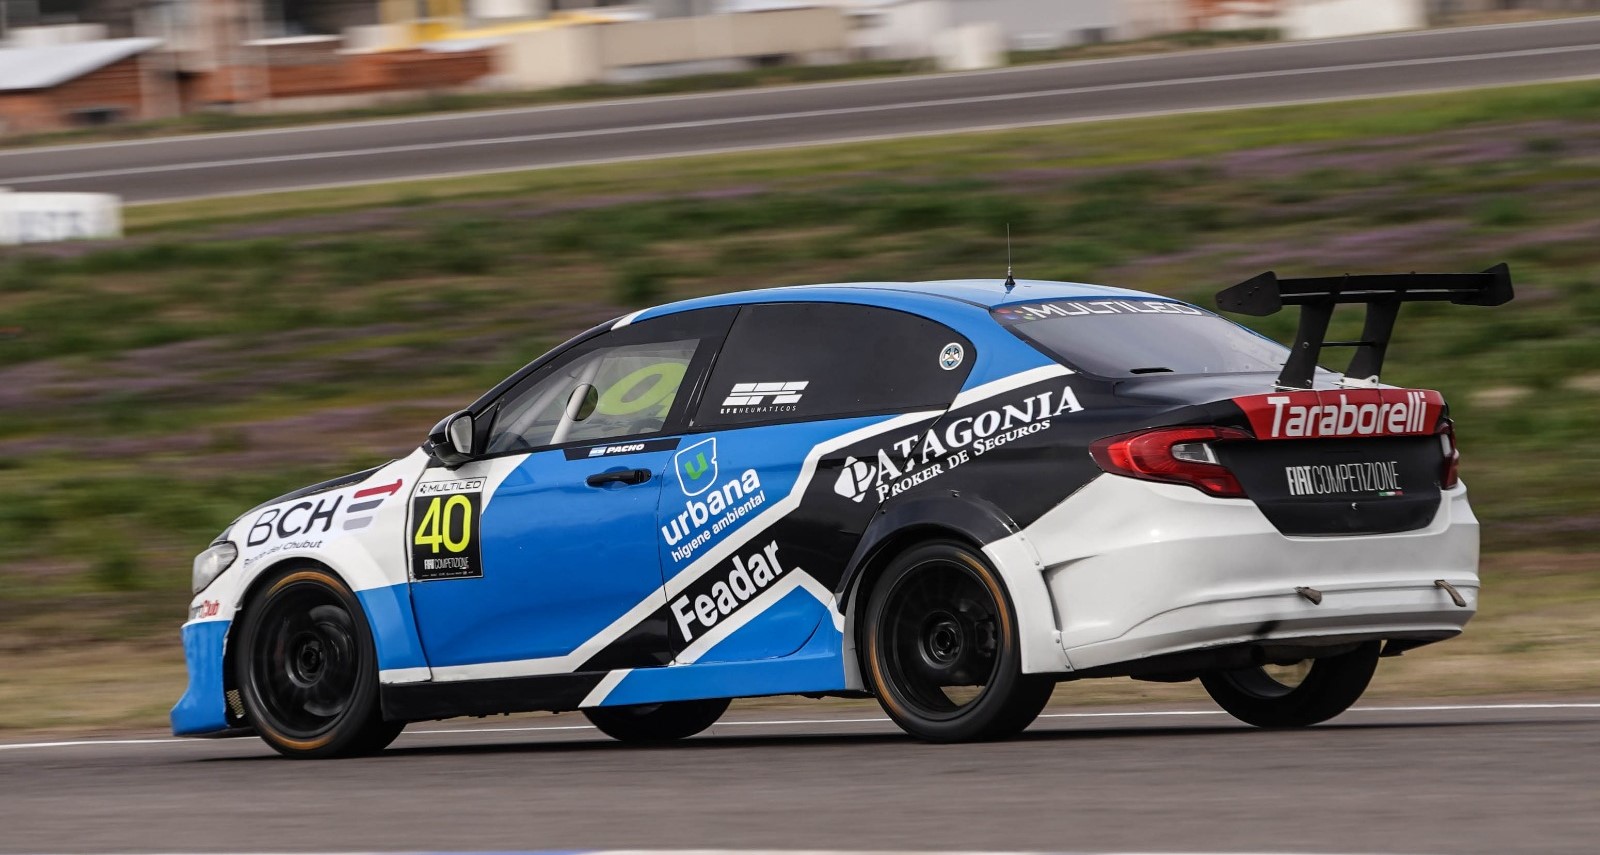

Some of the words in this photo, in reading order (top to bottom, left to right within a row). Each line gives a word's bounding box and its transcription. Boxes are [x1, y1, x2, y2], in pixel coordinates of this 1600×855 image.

[1021, 301, 1203, 319] MULTILED
[1267, 391, 1427, 438] Taraborelli
[606, 443, 645, 454] PACHO
[947, 449, 970, 470] DE
[973, 419, 1051, 457] SEGUROS
[427, 480, 482, 493] MULTILED
[661, 468, 761, 546] urbana
[247, 495, 343, 547] BCH
[414, 494, 472, 554] 40
[671, 530, 712, 562] higiene
[711, 490, 766, 534] ambiental
[670, 540, 783, 643] Feadar
